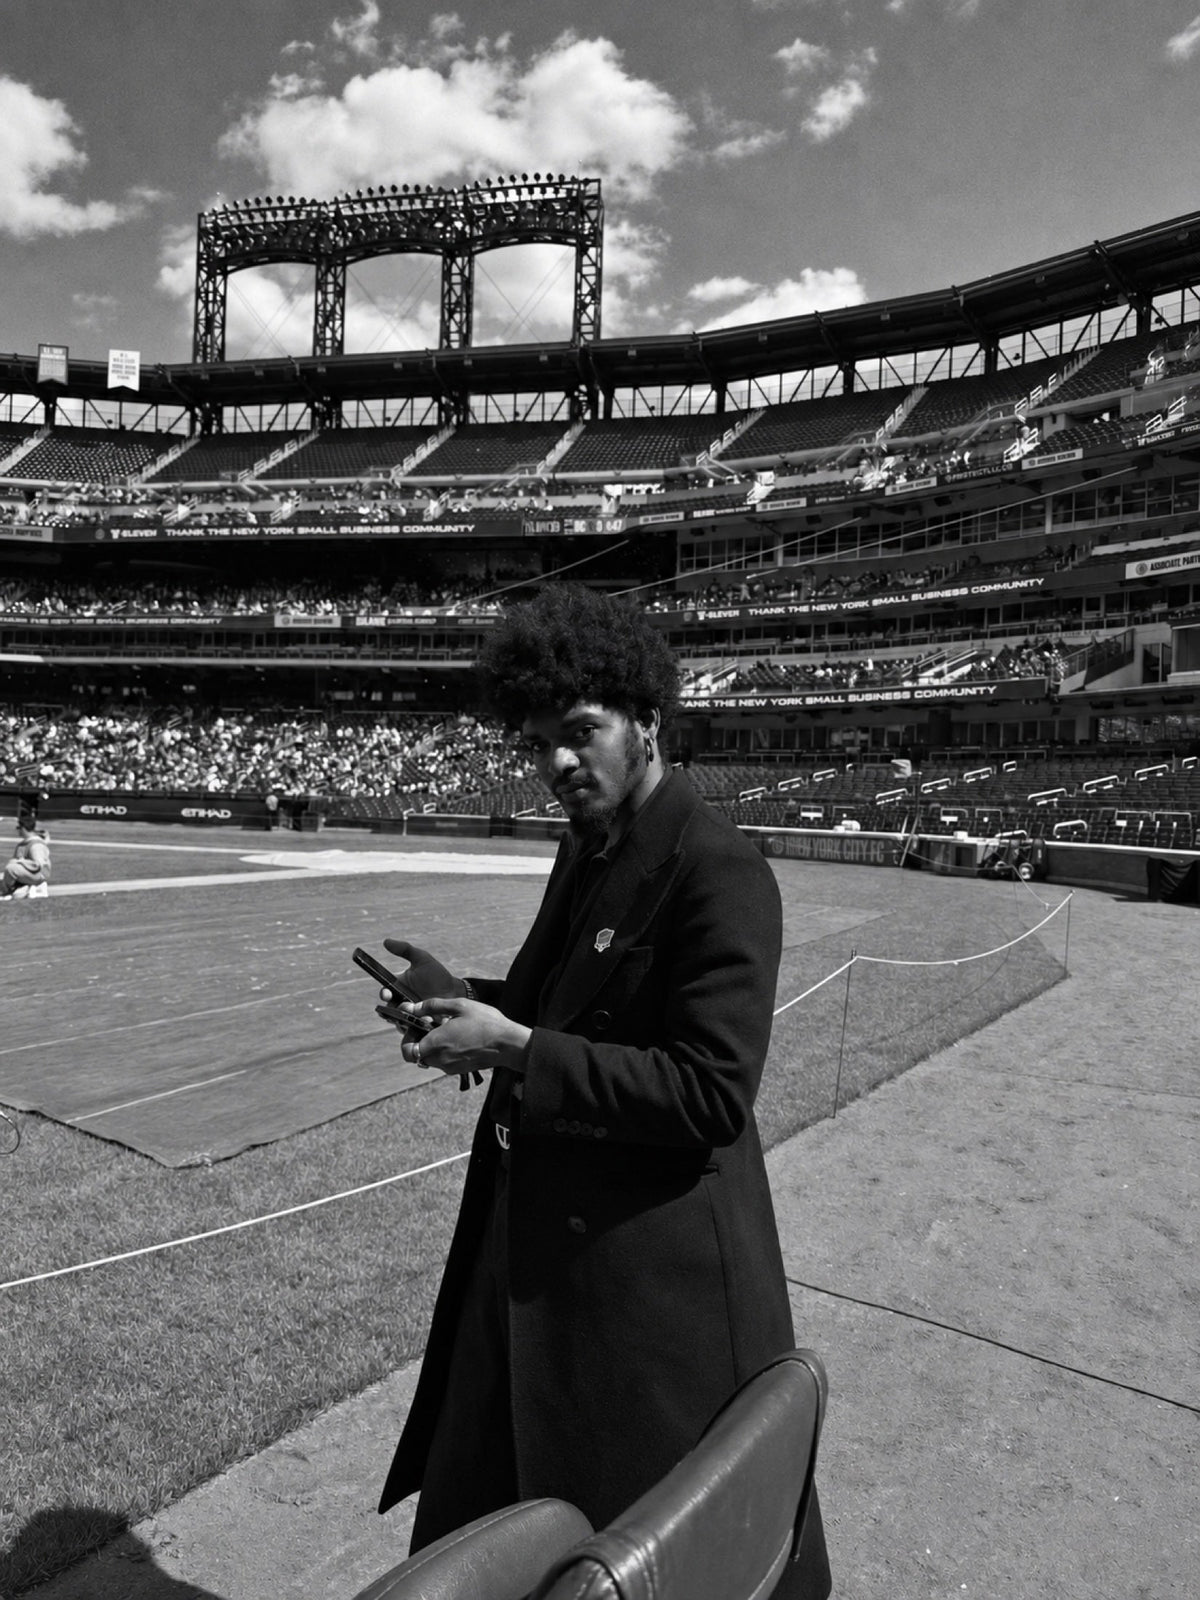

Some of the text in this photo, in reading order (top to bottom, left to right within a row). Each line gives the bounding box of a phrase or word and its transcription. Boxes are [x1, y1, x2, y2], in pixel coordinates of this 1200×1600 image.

[165, 528, 204, 537] THANK
[207, 528, 231, 536] THE
[232, 527, 260, 536] NEW
[262, 527, 294, 535] YORK
[297, 526, 337, 535] SMALL
[339, 525, 400, 534] BUSINESS
[402, 524, 475, 534] COMMUNITY
[748, 606, 786, 617] THANK
[787, 604, 810, 614] THE
[811, 602, 839, 612] NEW
[840, 600, 869, 611] YORK
[871, 596, 909, 607] SMALL
[911, 587, 969, 601] BUSINESS
[971, 578, 1044, 594] COMMUNITY
[680, 700, 711, 708] ANK
[770, 698, 803, 706] YORK
[805, 695, 846, 705] SMALL
[848, 691, 911, 703] BUSINESS
[914, 685, 998, 699] COMMUNITY
[79, 804, 127, 815] ETIHAD
[181, 807, 232, 819] ETIHAD
[812, 837, 841, 860] YORK
[842, 838, 869, 862] CITY
[870, 840, 885, 863] FC
